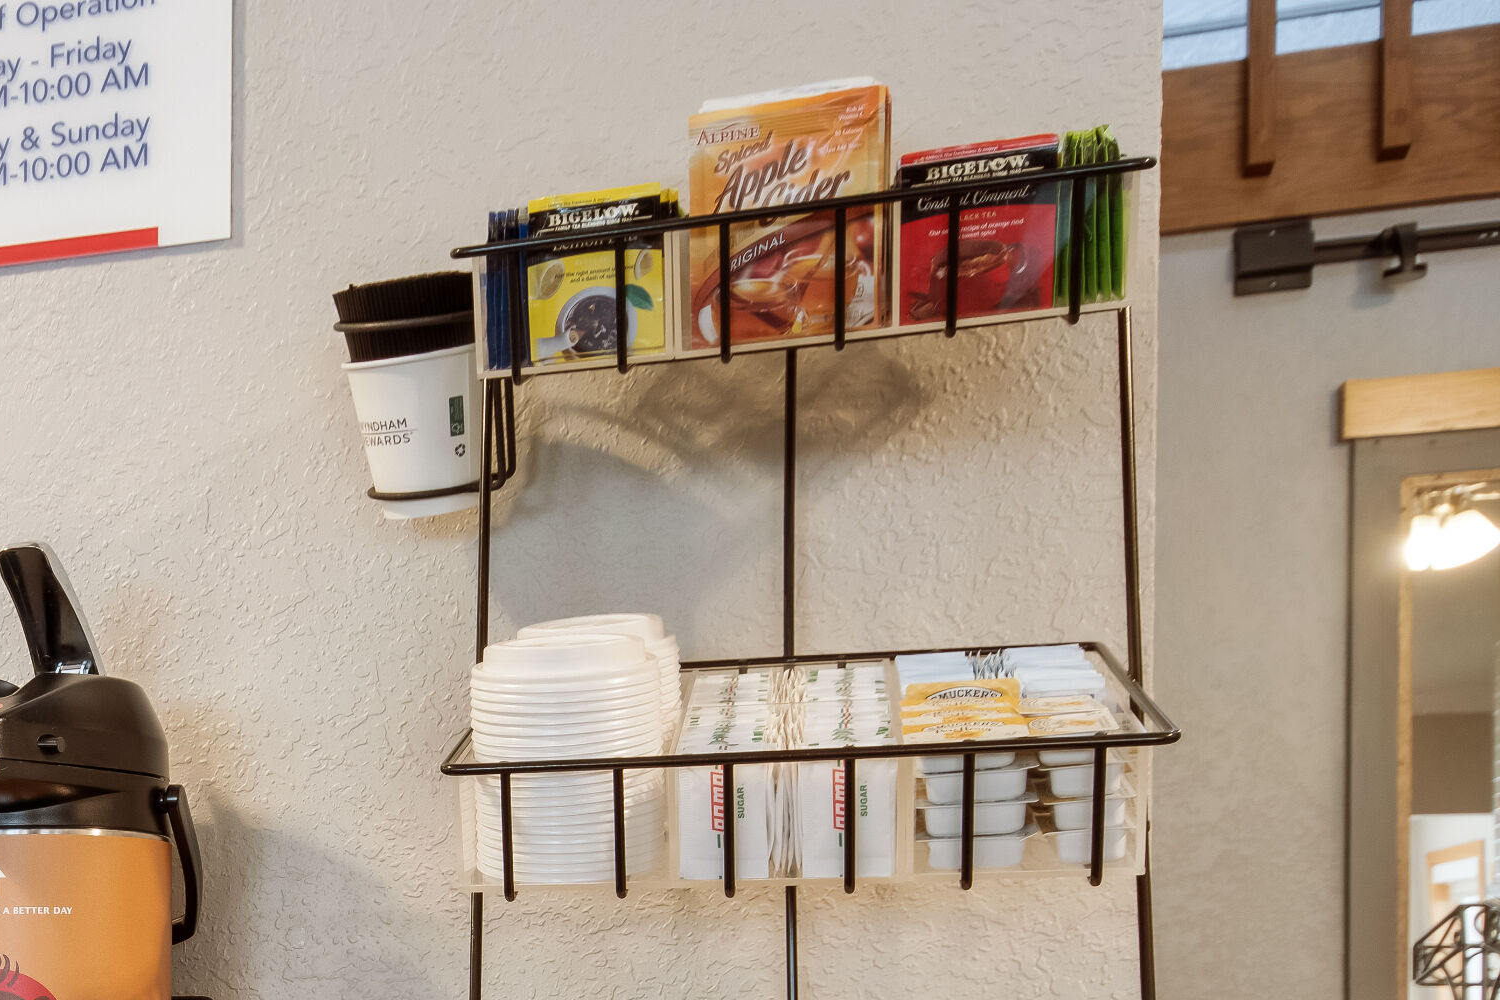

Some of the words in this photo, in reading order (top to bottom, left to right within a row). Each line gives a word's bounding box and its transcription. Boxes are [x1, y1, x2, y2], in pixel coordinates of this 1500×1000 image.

[50, 36, 132, 69] Friday
[101, 63, 149, 93] AM
[20, 127, 41, 151] &
[51, 112, 150, 146] Sunday
[696, 126, 760, 146] ALPINE
[100, 143, 149, 172] AM
[714, 130, 773, 174] Spiced
[713, 139, 808, 215] Apple
[959, 213, 979, 221] LACK
[730, 232, 786, 272] RIGINAL
[360, 418, 409, 433] YNDHAM
[737, 786, 745, 819] SUGAR
[860, 784, 868, 817] SUGAR
[3, 906, 10, 915] A
[13, 906, 50, 914] BETTER
